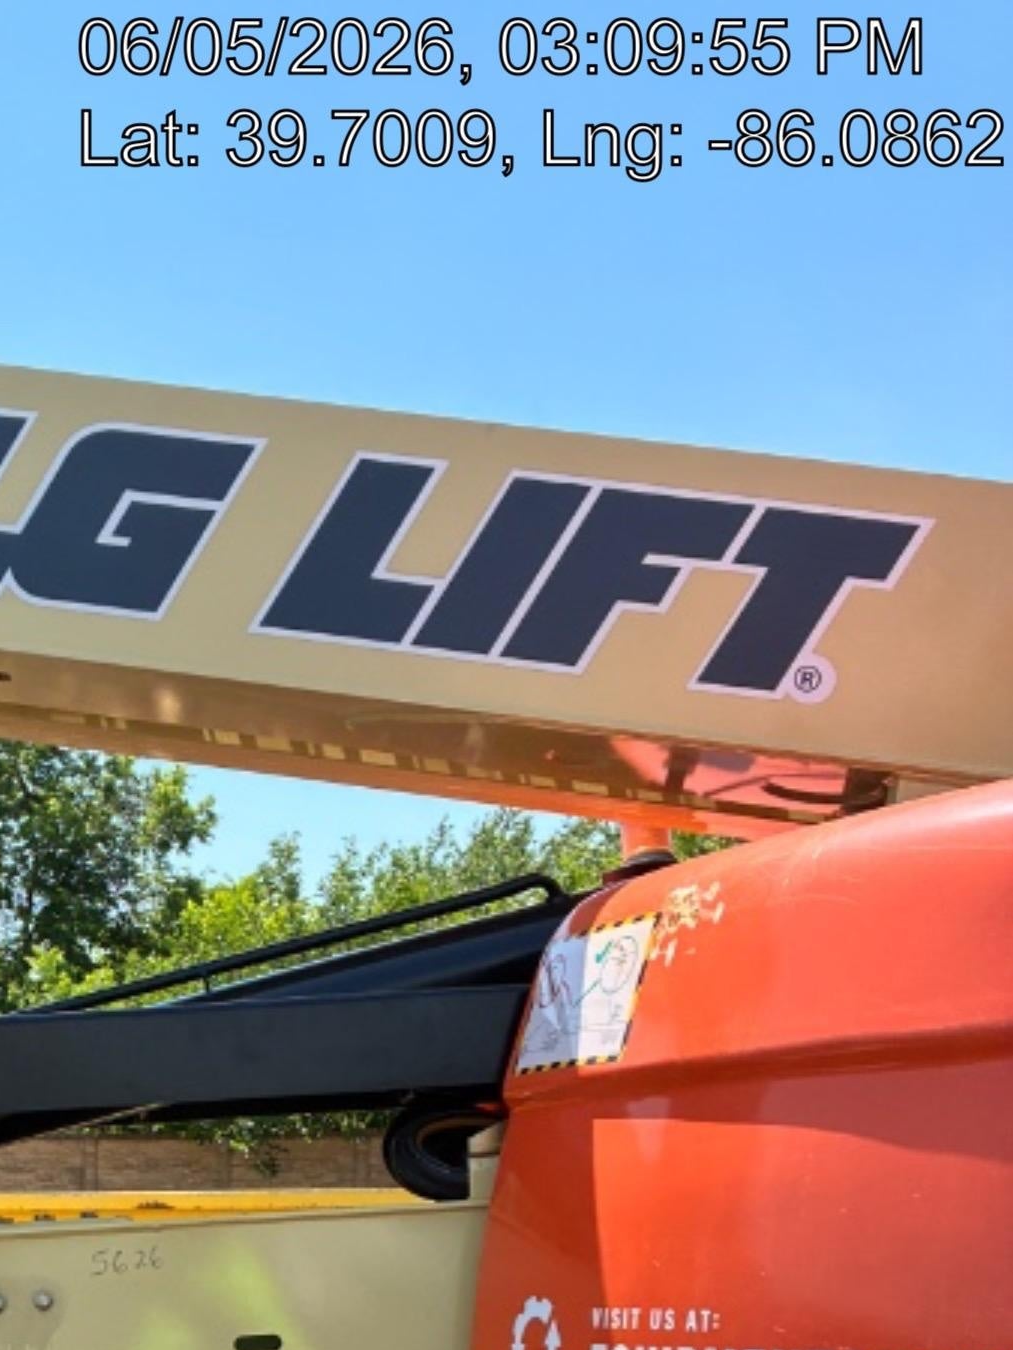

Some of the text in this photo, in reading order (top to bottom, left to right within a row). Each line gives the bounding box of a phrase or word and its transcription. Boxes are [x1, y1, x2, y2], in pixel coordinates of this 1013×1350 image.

[248, 451, 936, 700] LIFT
[591, 1307, 721, 1333] VISIT US AT:
